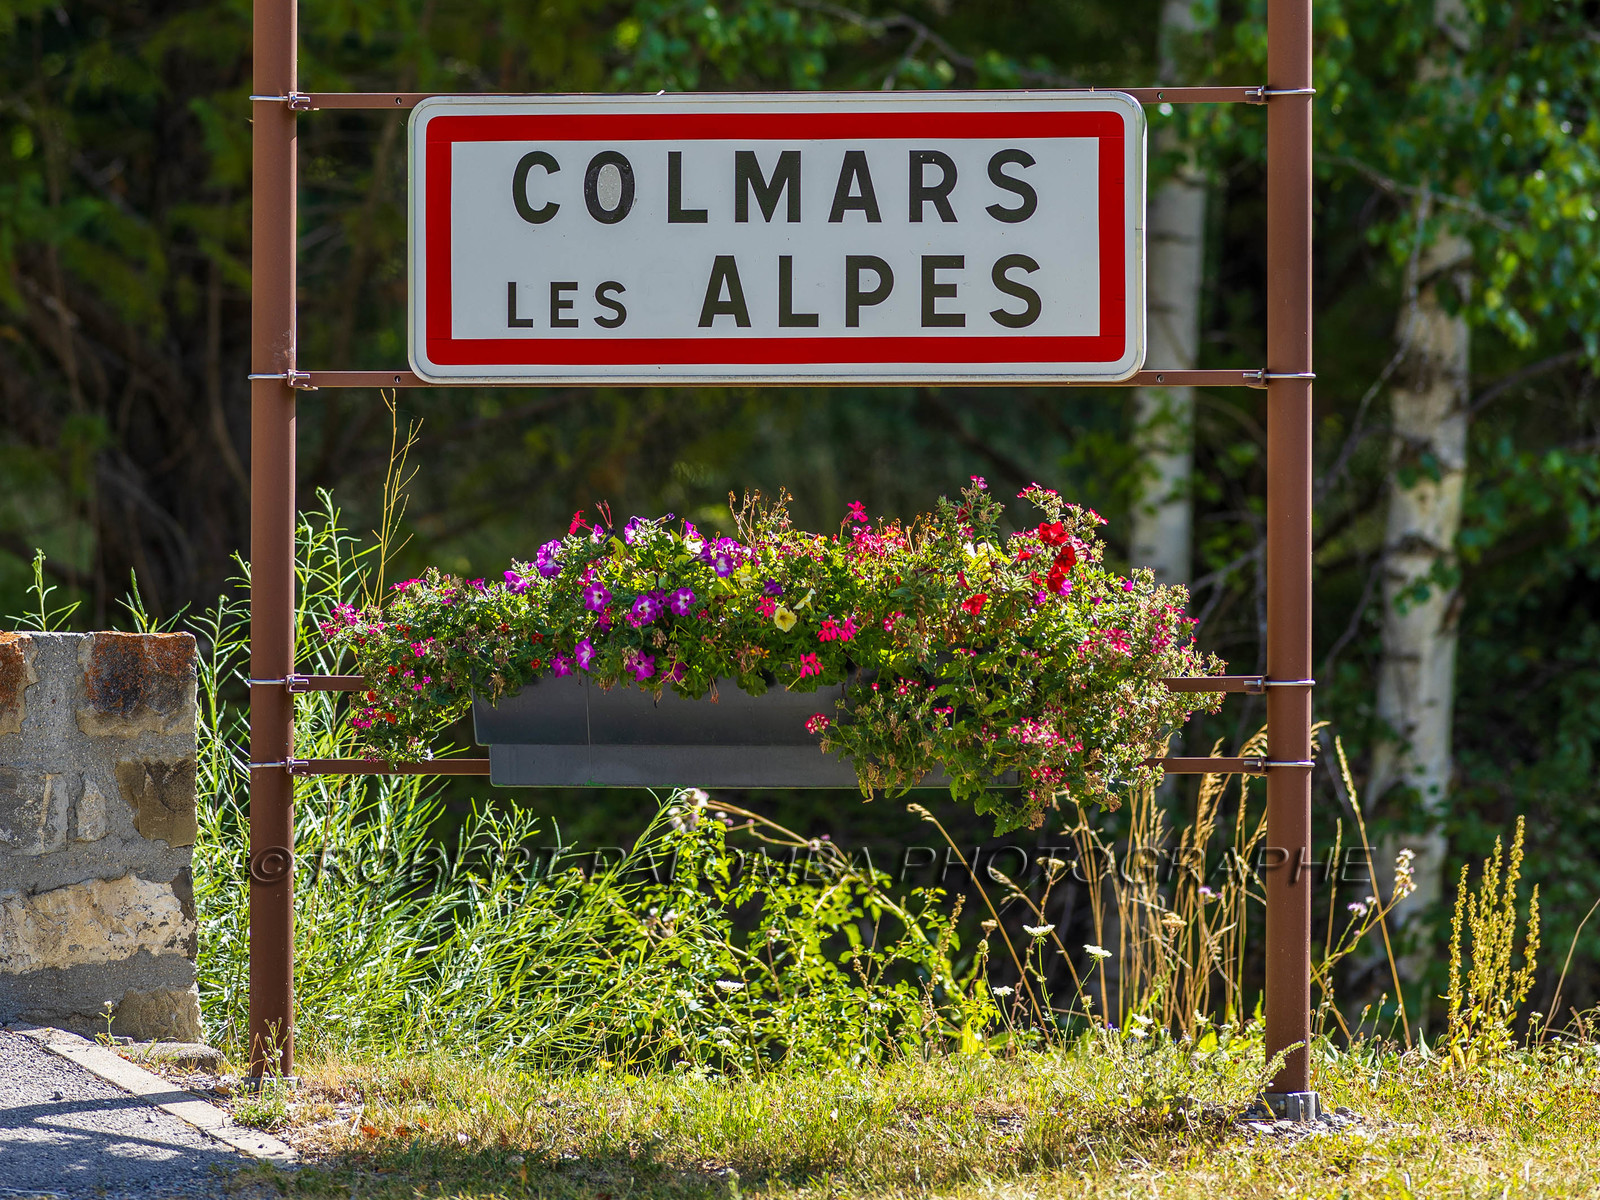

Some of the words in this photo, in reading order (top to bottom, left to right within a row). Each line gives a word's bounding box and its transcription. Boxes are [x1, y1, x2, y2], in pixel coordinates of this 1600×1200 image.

[511, 148, 1039, 225] COLMARS
[506, 280, 629, 329] LES
[697, 254, 1043, 329] ALPES
